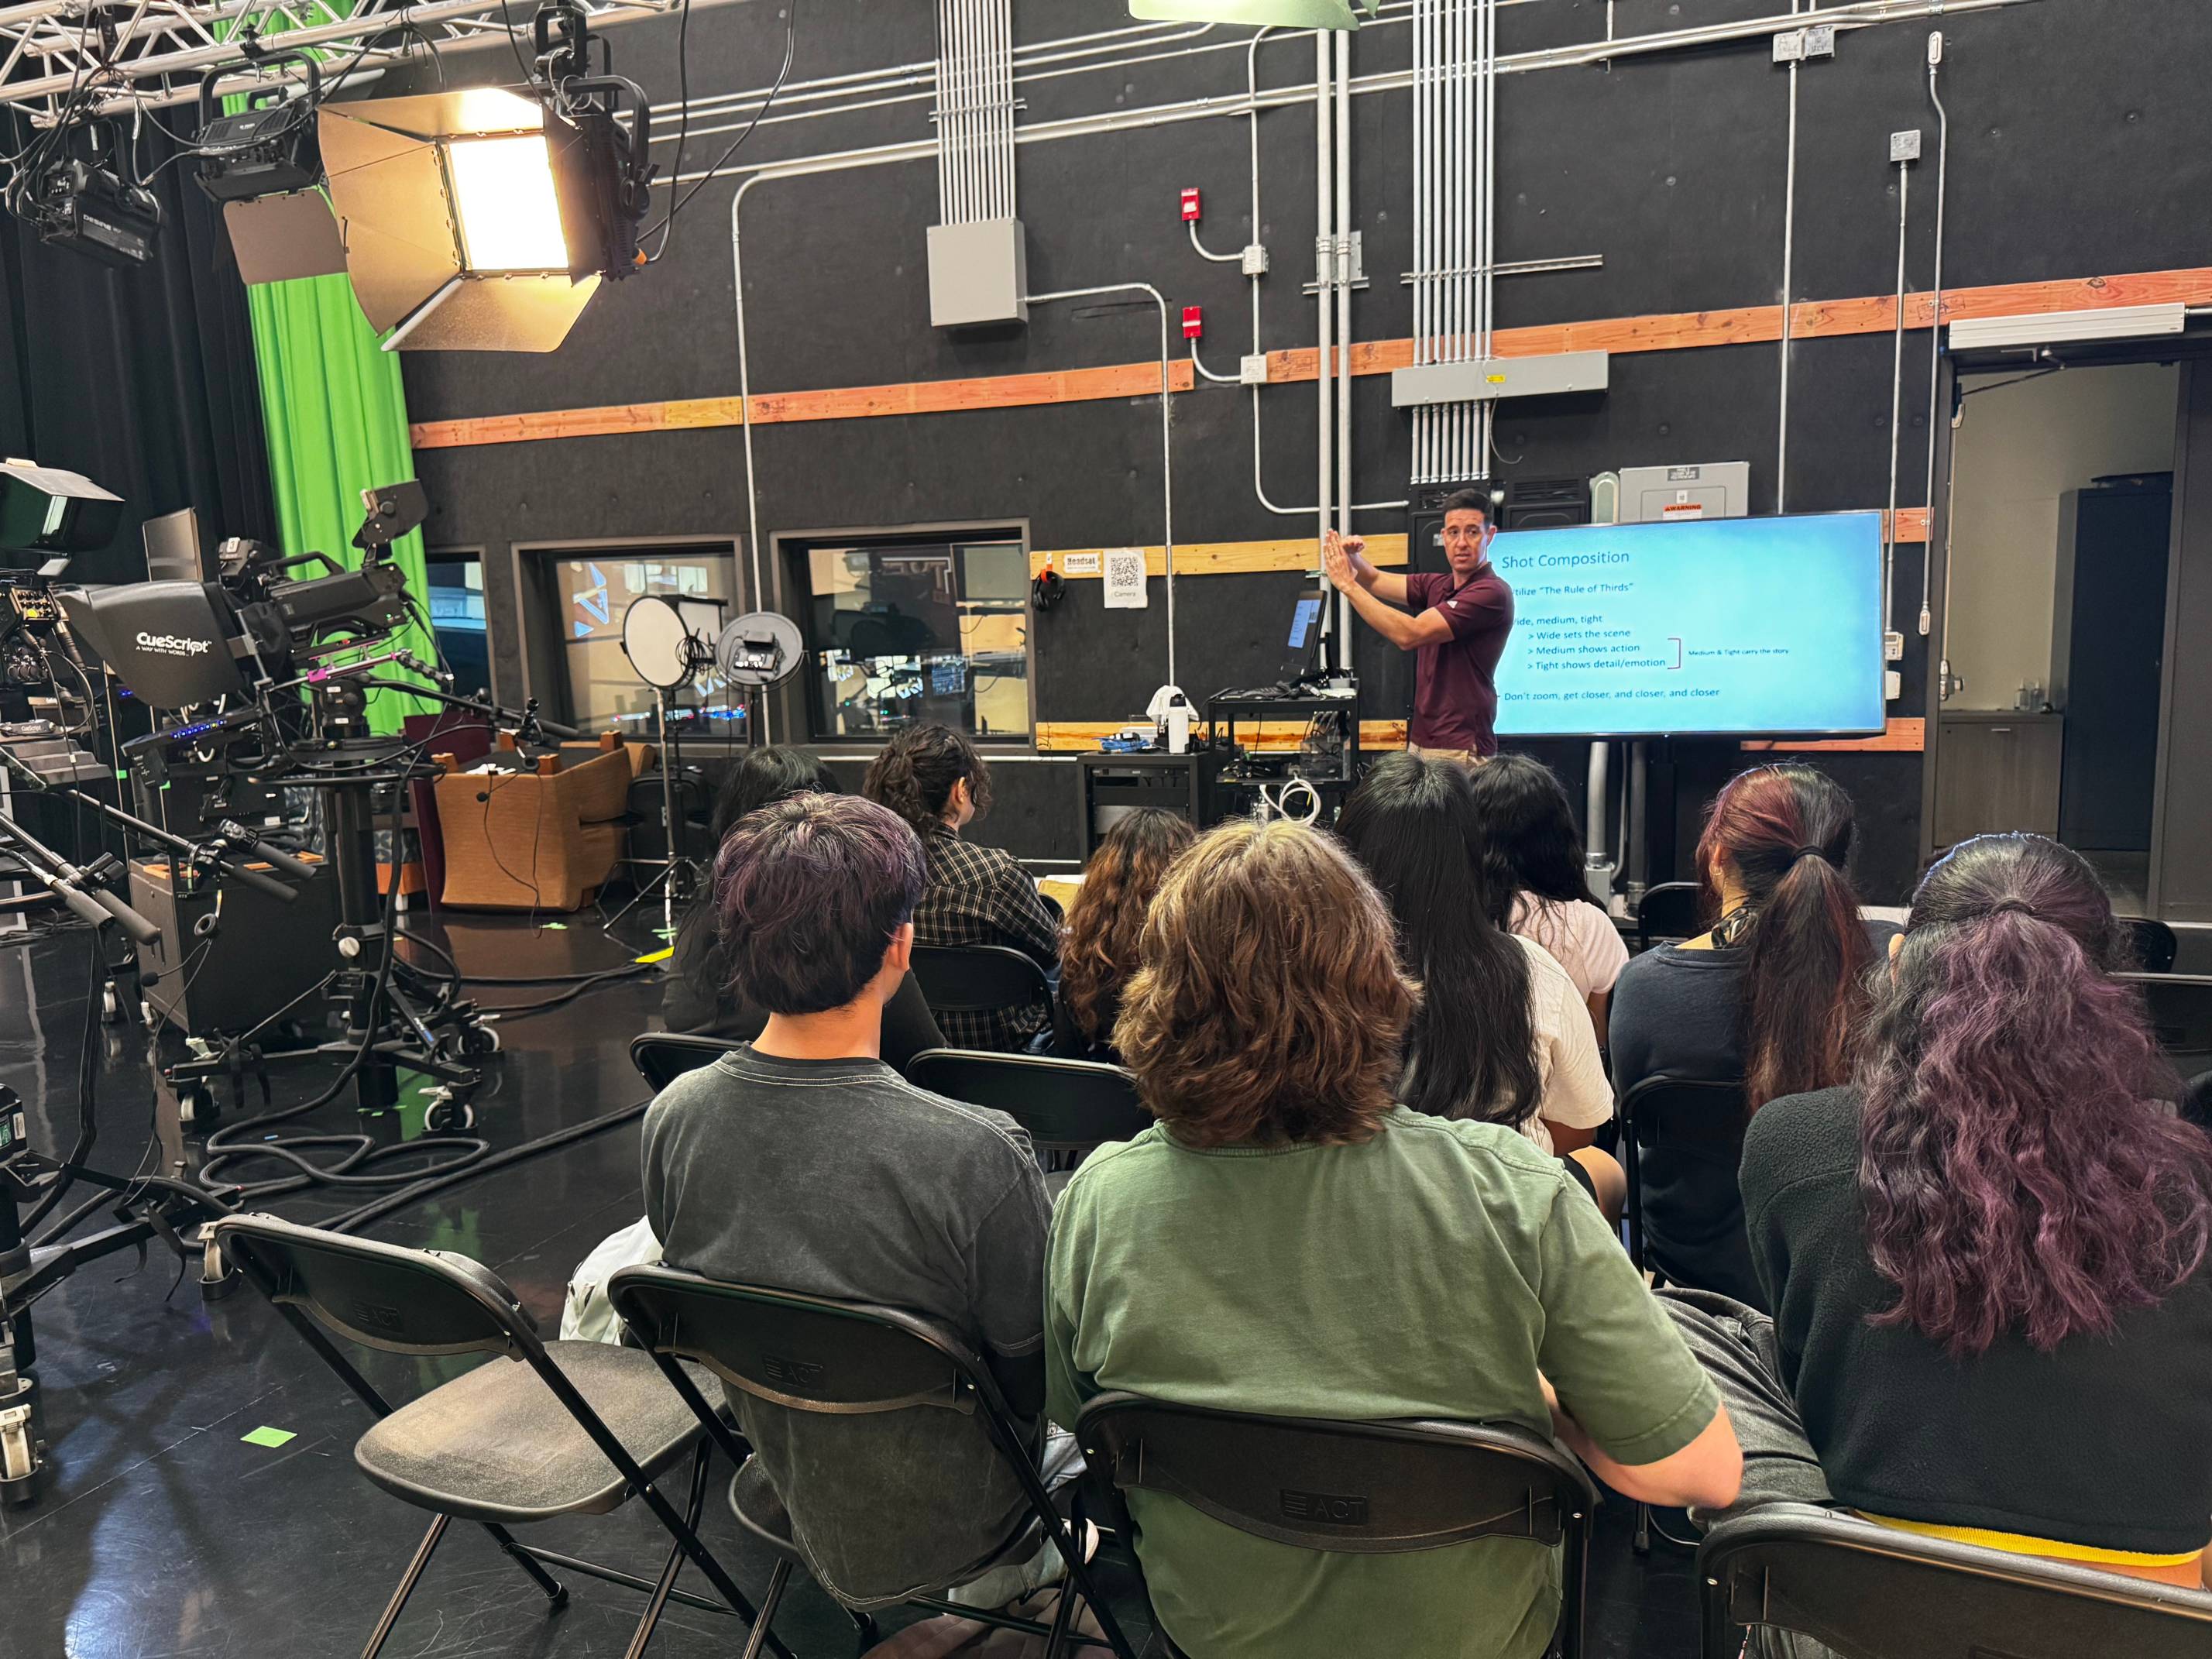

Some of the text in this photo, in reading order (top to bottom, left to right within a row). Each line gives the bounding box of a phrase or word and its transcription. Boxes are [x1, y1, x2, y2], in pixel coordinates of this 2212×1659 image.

[1502, 551, 1630, 568] Shot Composition
[1565, 585, 1585, 594] Rule
[1588, 584, 1597, 593] of
[1514, 614, 1602, 627] ide, medium, tight
[1537, 631, 1561, 640] Wide
[1563, 630, 1582, 639] sets
[1585, 630, 1600, 638] the
[1536, 646, 1575, 655] Medium
[1578, 645, 1609, 654] shows
[1611, 644, 1640, 653] action
[1535, 661, 1559, 672] Tight
[1561, 660, 1591, 669] shows
[1593, 658, 1666, 669] detail/emotion
[1532, 692, 1561, 702] zoom,
[1563, 692, 1578, 702] get
[1582, 689, 1612, 700] closer,
[1614, 689, 1633, 699] and
[1635, 689, 1667, 699] closer,
[1668, 688, 1688, 698] and
[1690, 688, 1720, 697] closer
[1313, 1498, 1365, 1520] ACT
